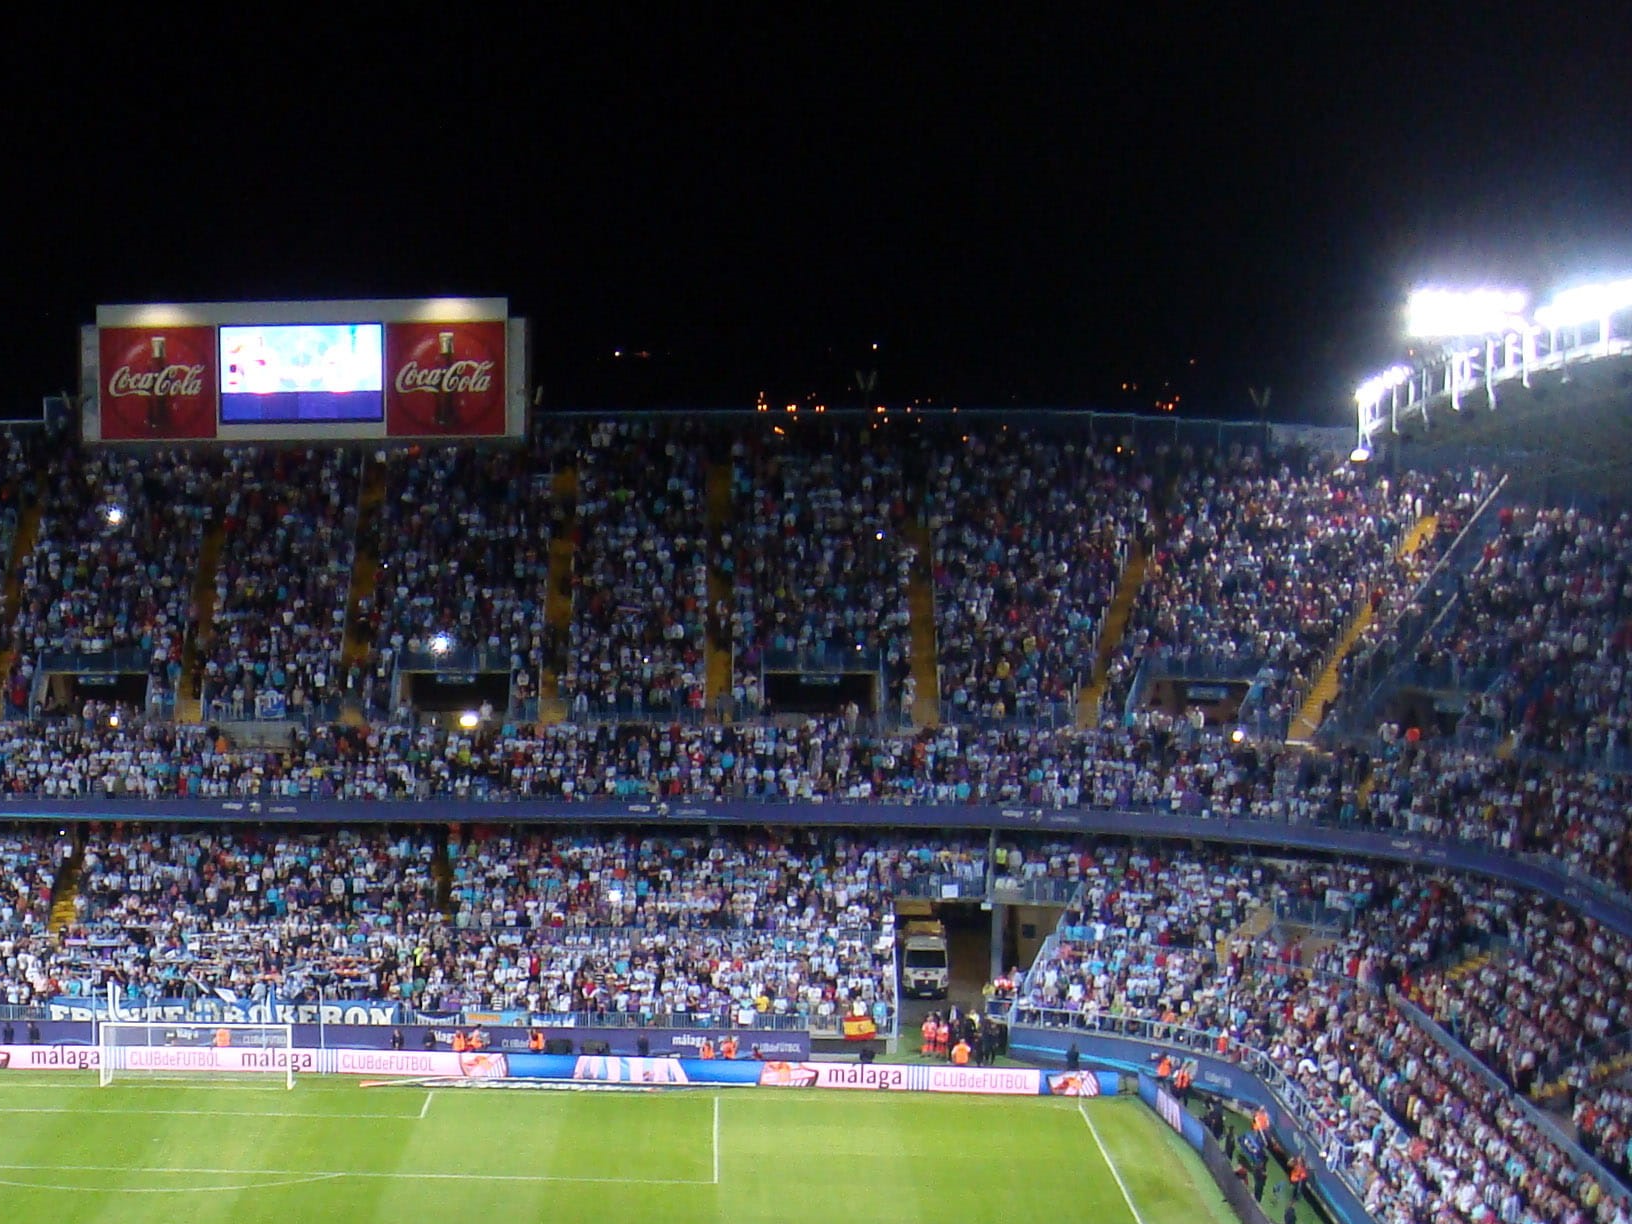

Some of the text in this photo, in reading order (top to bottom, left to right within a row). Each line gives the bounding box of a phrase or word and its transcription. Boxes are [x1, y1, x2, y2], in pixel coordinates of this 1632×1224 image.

[108, 364, 205, 398] Coca-Cola
[395, 360, 495, 394] Coca-Cola
[30, 1044, 100, 1069] málaga
[828, 1063, 902, 1089] málaga
